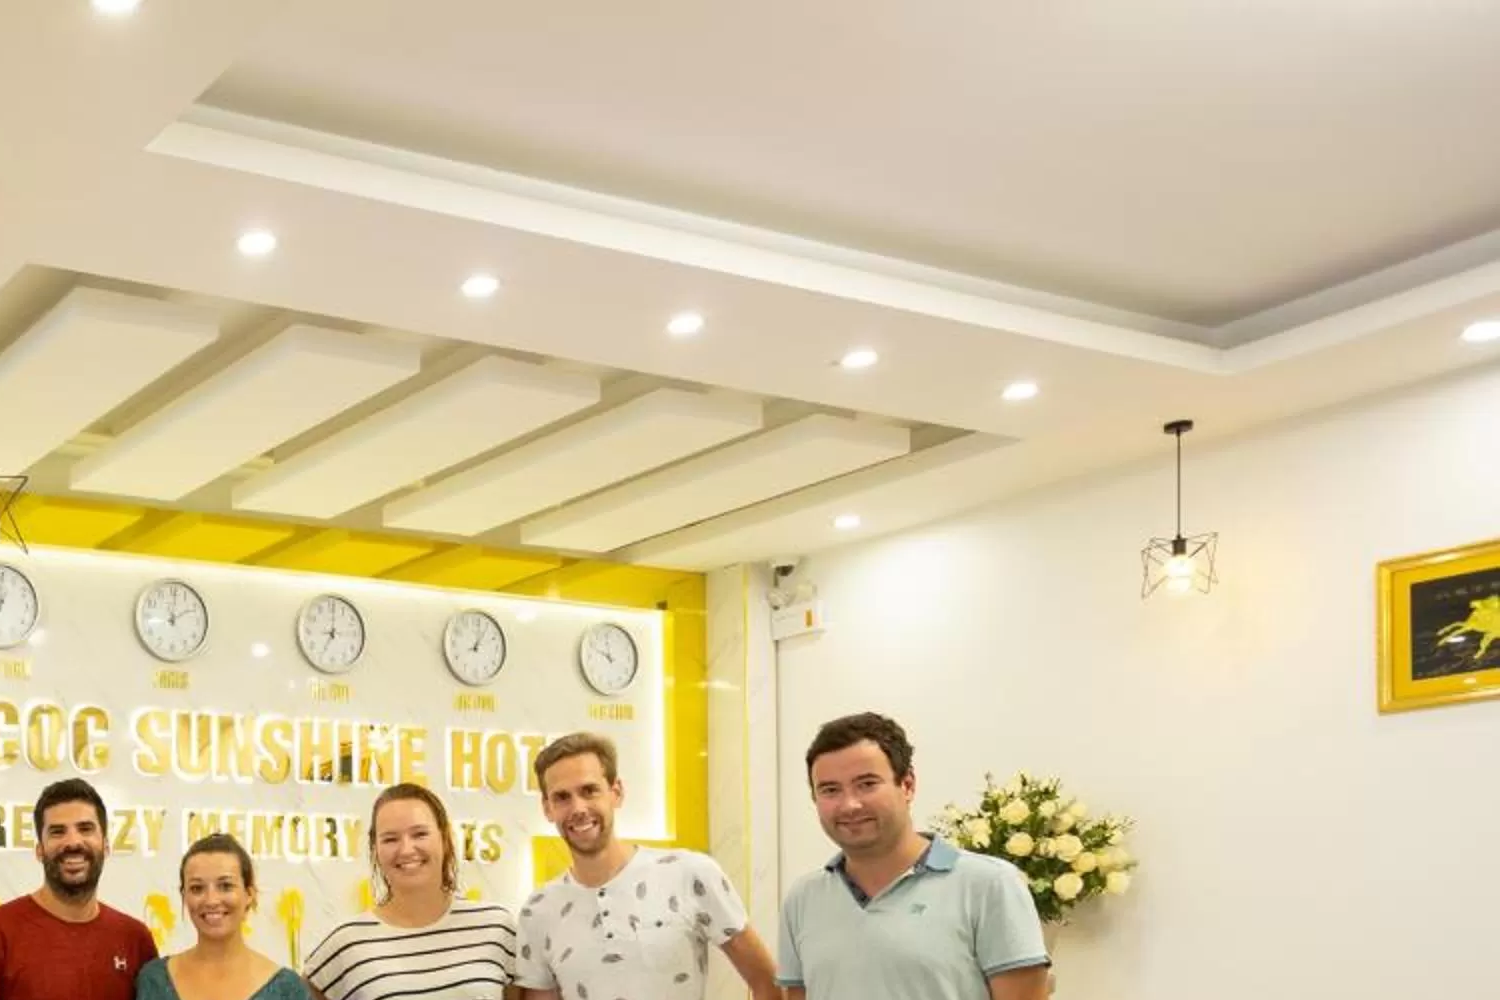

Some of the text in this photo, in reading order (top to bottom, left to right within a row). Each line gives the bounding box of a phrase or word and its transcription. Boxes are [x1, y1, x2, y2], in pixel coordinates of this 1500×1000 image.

[134, 708, 429, 784] SUNSHINE
[451, 731, 547, 793] HOT
[110, 809, 168, 854] ZY
[187, 811, 363, 858] MEMORY
